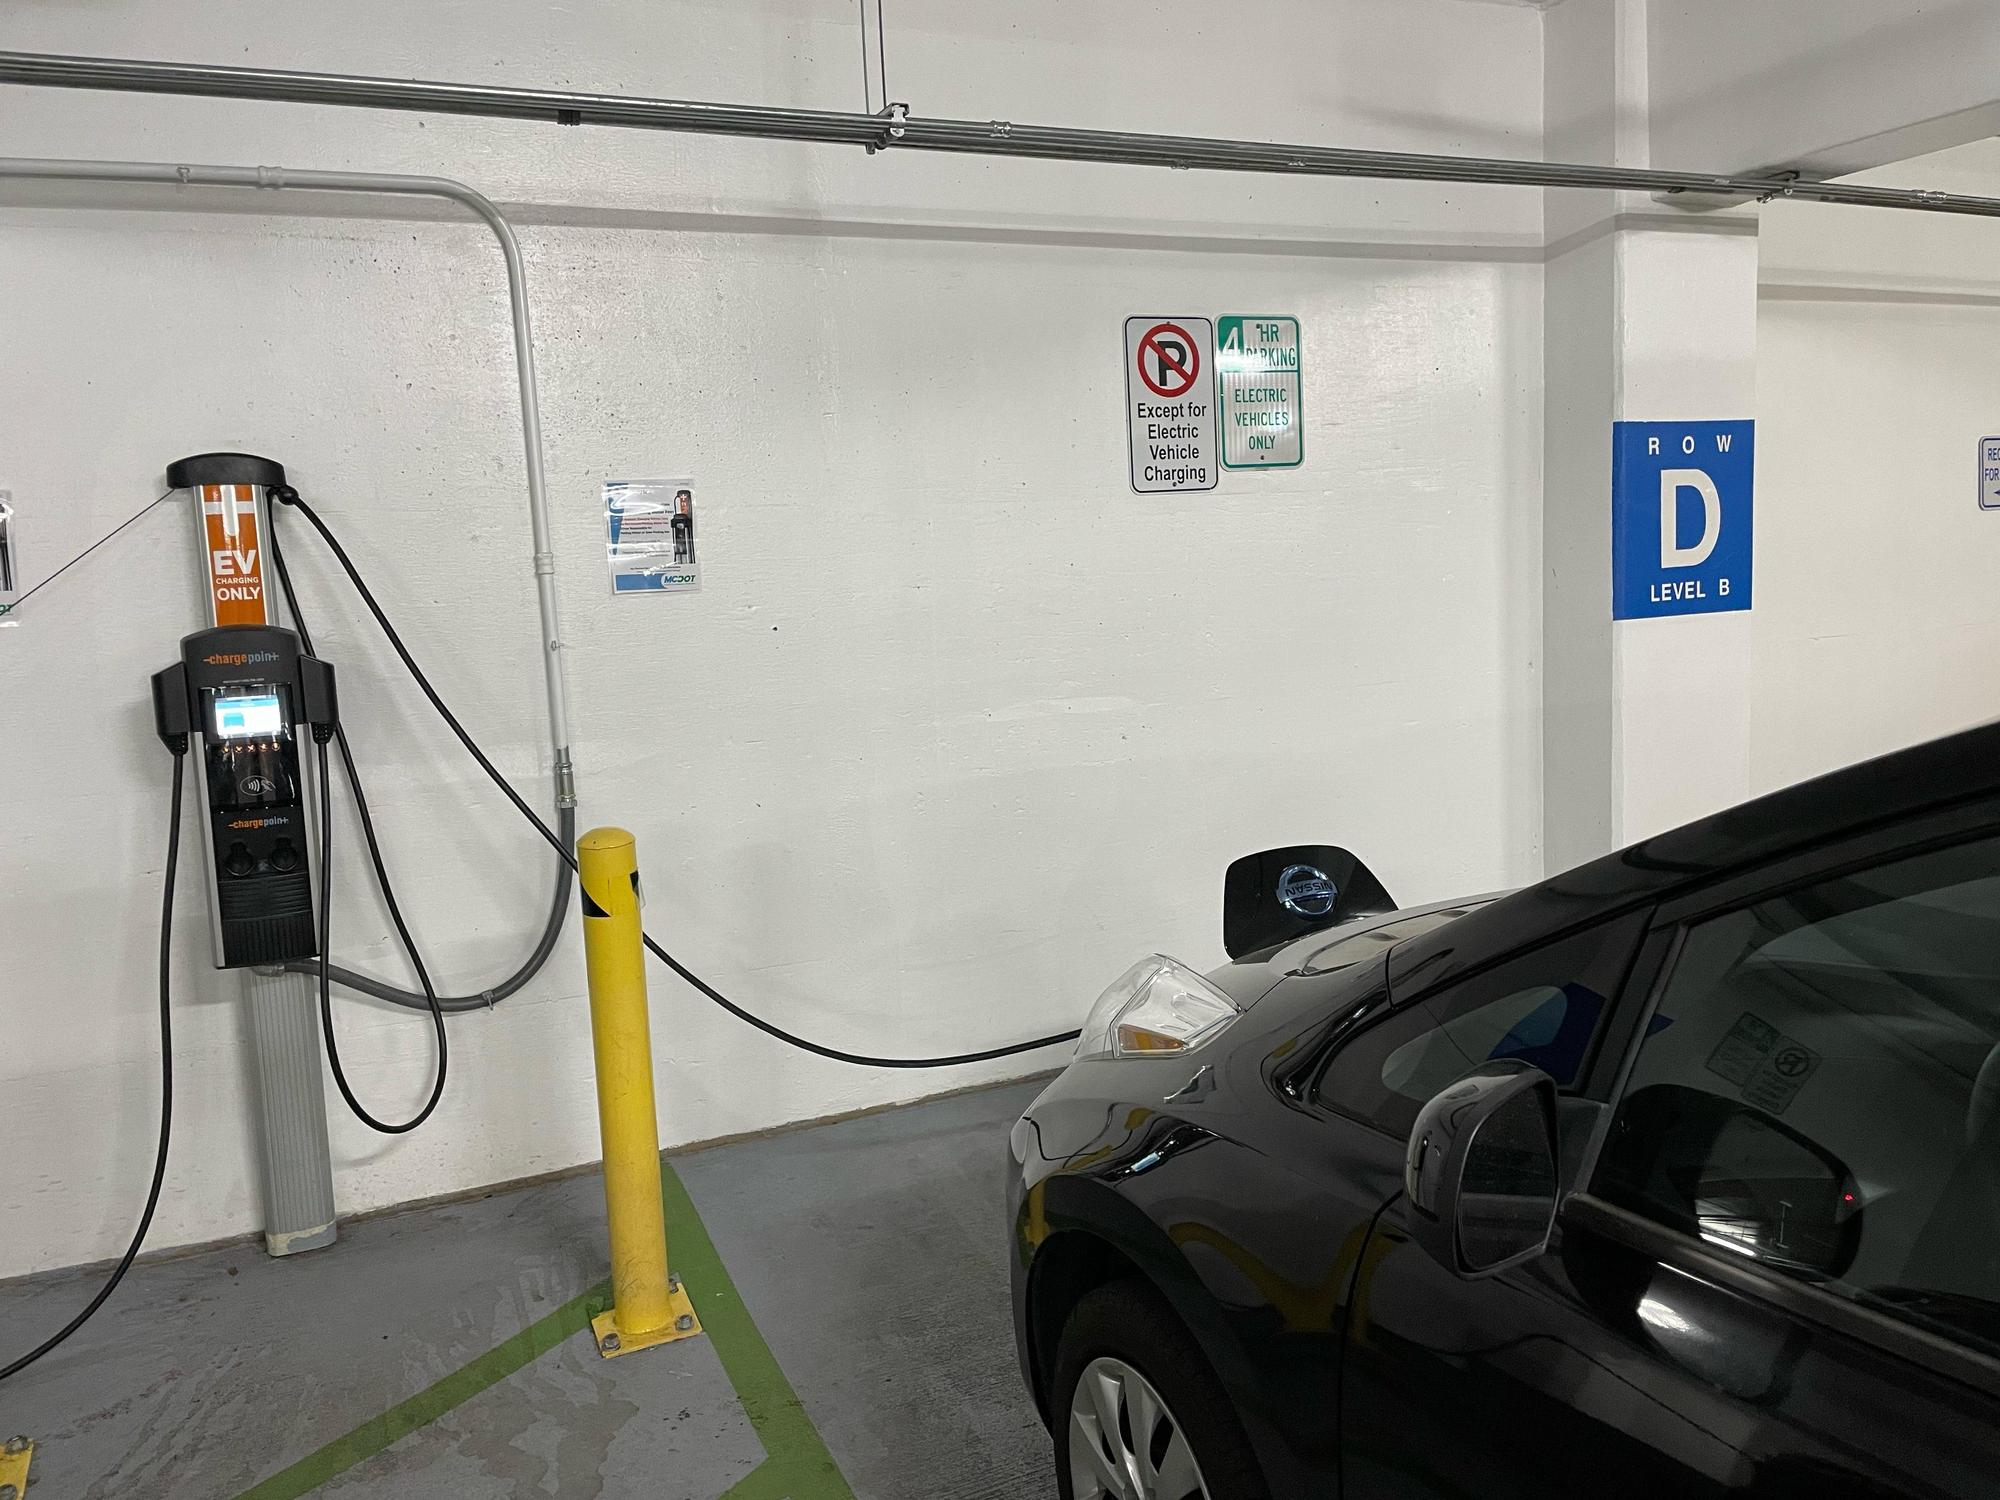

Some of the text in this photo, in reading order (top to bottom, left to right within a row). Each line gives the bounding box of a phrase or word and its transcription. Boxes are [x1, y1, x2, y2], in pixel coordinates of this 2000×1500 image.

[1260, 323, 1280, 342] HR
[1246, 347, 1296, 366] PRKING
[1235, 388, 1287, 403] ELECTRIC
[1137, 402, 1207, 421] Except for
[1235, 411, 1289, 427] VEHICLES
[1148, 423, 1199, 439] Electric
[1248, 435, 1276, 450] ONLY
[1149, 444, 1200, 460] Vehicle
[1144, 466, 1206, 484] Charging
[1985, 467, 2000, 481] FOR
[1660, 468, 1721, 569] D
[213, 549, 257, 575] EV
[215, 576, 259, 585] CHARGING
[664, 574, 696, 583] MCDOT
[216, 586, 261, 601] ONLY
[1651, 578, 1730, 602] LEVEL B
[1285, 881, 1333, 896] NISSAN
